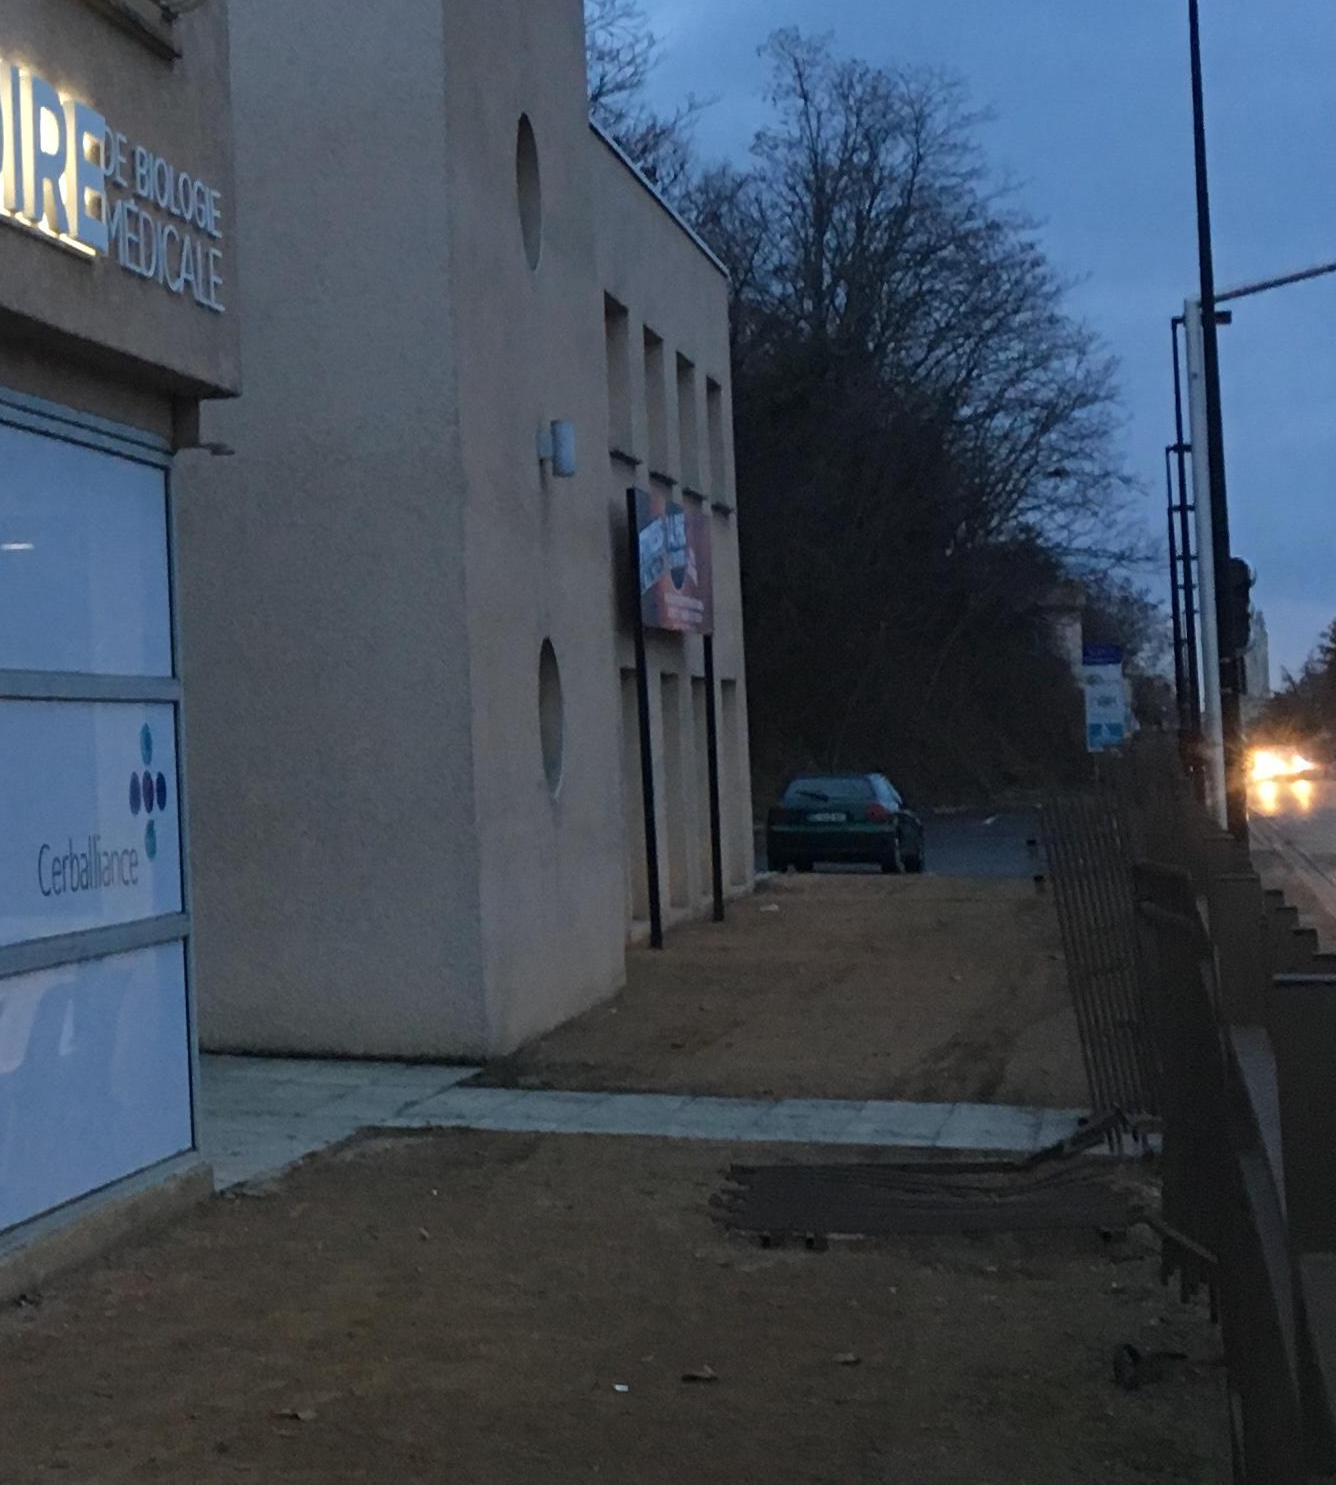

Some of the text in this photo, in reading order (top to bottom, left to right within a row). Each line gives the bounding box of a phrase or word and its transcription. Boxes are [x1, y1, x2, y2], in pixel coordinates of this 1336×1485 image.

[104, 126, 223, 238] DE BIOLOGIE
[38, 833, 139, 897] Cerballiance
